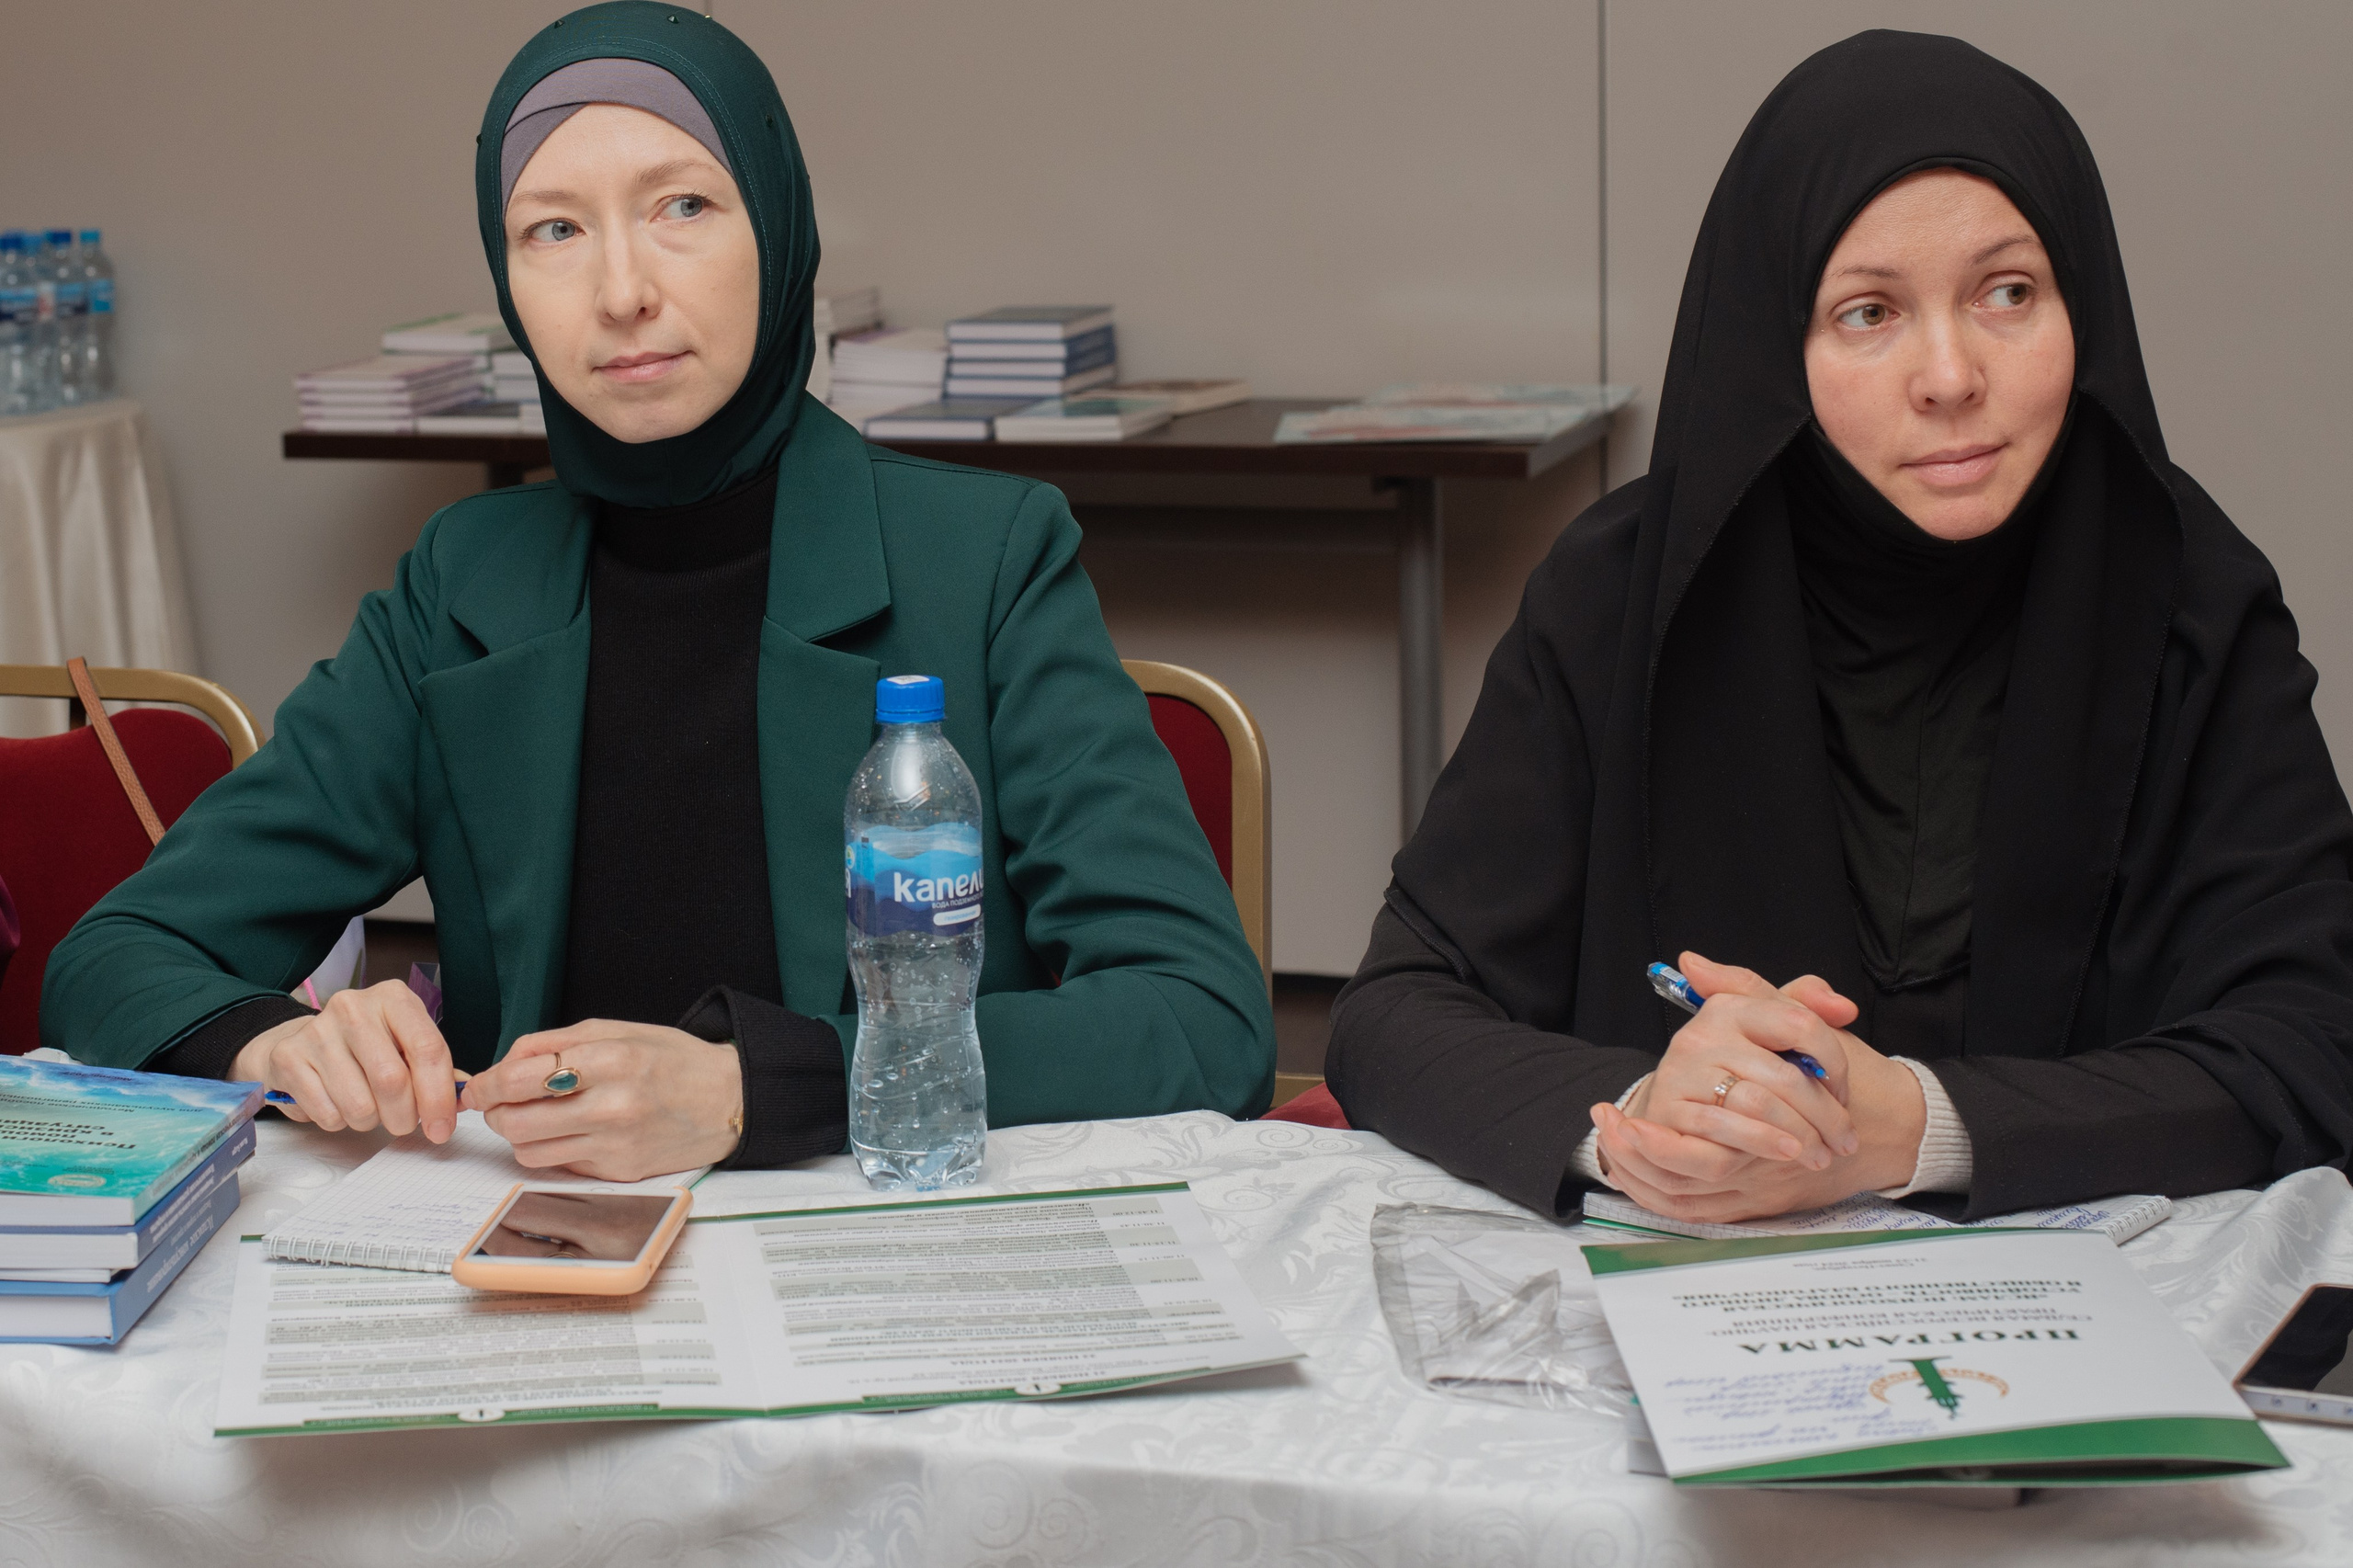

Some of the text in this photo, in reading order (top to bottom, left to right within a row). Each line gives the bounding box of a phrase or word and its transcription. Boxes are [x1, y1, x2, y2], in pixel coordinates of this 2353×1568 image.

[1865, 1280, 2061, 1291] ОБЩЕСТВЕННОГО
[1904, 1287, 2080, 1296] УСТОЙЧИВОСТЬ
[1672, 1286, 1859, 1301] БЛАГОПОЛУЧИЯ»
[1794, 1292, 1882, 1301] ОСНОВА
[1682, 1297, 1787, 1308] ЛИЧНОГО
[1723, 1297, 1947, 1312] ПСИХОЛОГИЧЕСКАЯ
[1732, 1308, 2056, 1327] ПРАКТИЧЕСКАЯ КОНФЕРЕНЦИЯ
[1738, 1330, 2082, 1355] ПРОГРАММА
